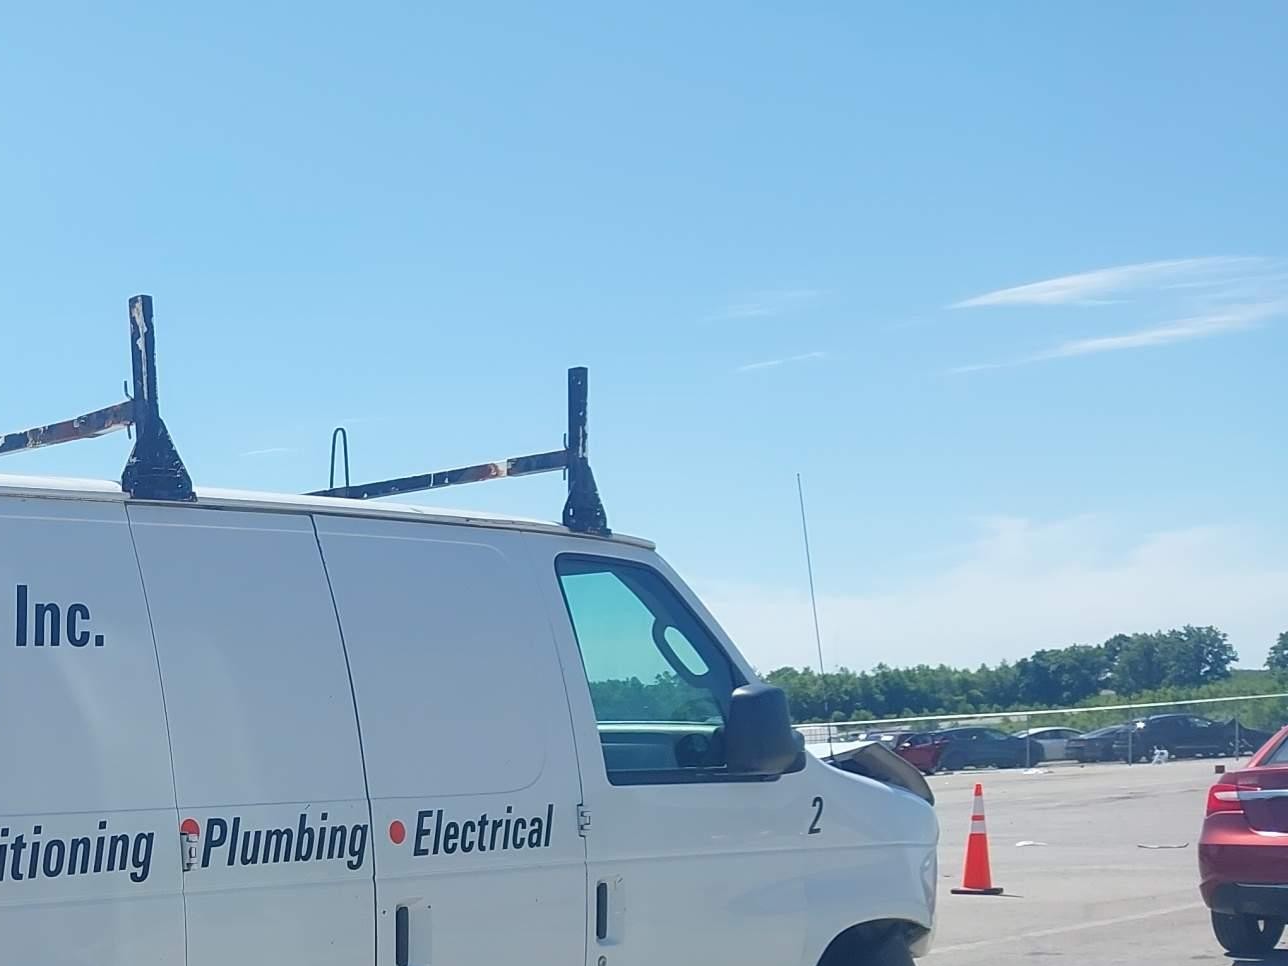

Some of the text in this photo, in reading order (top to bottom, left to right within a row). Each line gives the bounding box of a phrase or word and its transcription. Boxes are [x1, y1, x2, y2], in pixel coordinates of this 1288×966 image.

[15, 584, 106, 648] Inc.
[200, 812, 369, 870] Plumbing
[413, 804, 554, 857] Electrical
[808, 796, 824, 835] 2
